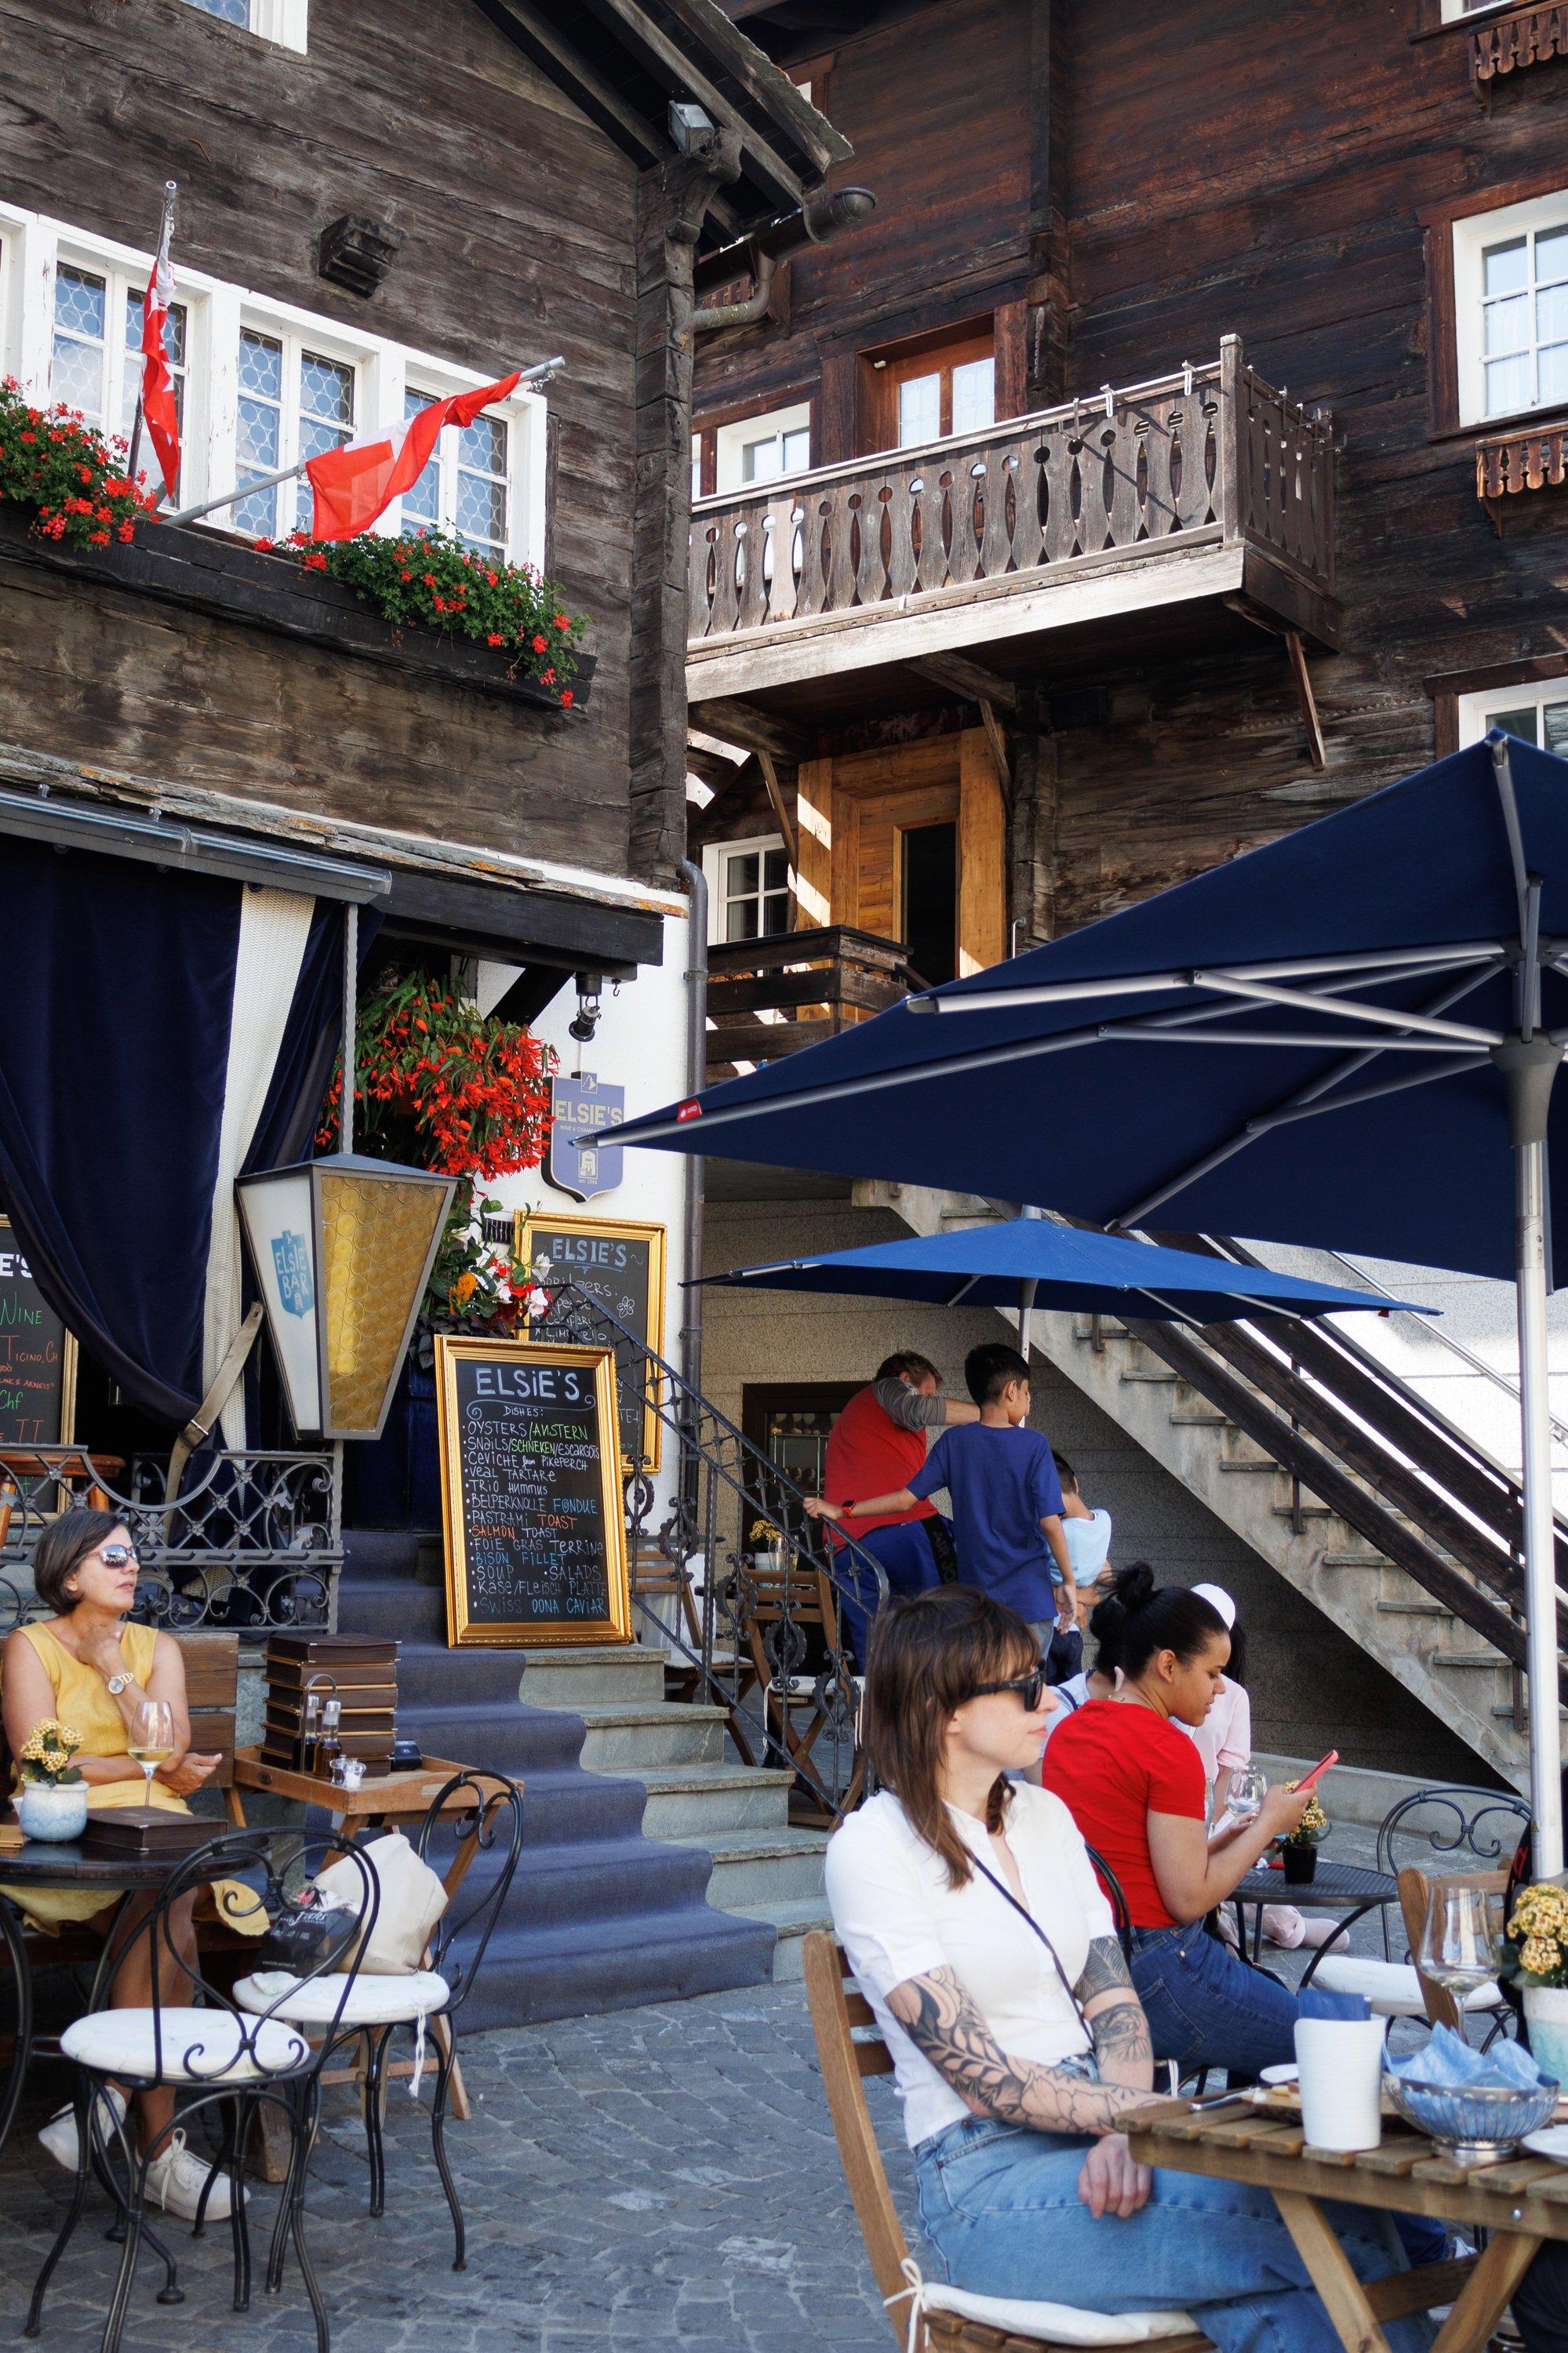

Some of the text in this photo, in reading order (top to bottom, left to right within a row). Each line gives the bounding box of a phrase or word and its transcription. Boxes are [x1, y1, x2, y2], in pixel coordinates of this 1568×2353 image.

[555, 1100, 623, 1126] ELSIE'S
[275, 1244, 307, 1275] ELSIE
[552, 1238, 627, 1267] ELSIE'S
[282, 1273, 309, 1299] BAR
[537, 1514, 578, 1529] TOAST
[471, 1524, 558, 1540] SALMON TOAST
[512, 1538, 544, 1551] GRAS
[476, 1564, 602, 1581] SOUP SALADS
[569, 1580, 607, 1596] PLATTE
[532, 1598, 560, 1614] OONA
